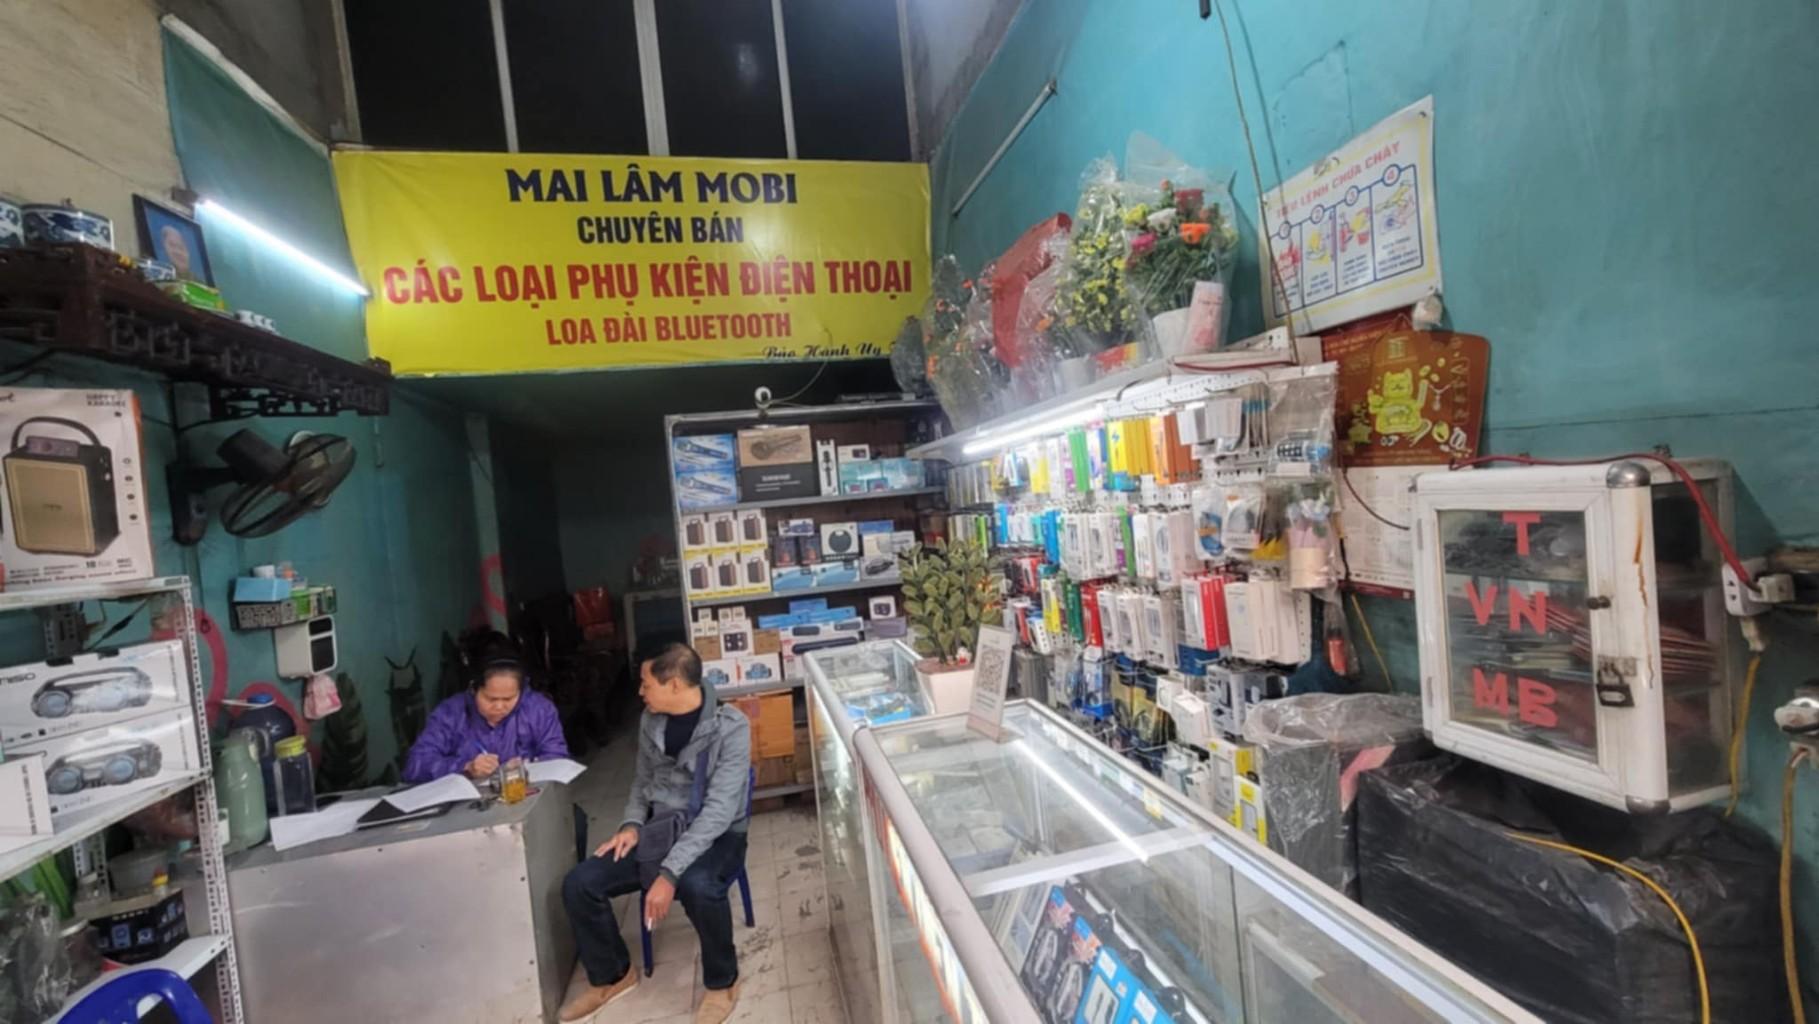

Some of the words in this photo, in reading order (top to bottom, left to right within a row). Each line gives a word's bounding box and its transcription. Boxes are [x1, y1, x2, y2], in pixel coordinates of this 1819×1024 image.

[505, 168, 588, 203] MAI
[600, 163, 684, 203] LÂM
[695, 171, 798, 204] MOBI
[577, 210, 683, 244] CHUYÊN
[691, 211, 744, 244] BÁN
[383, 258, 463, 304] CÁC
[473, 264, 557, 309] LOẠI
[567, 263, 639, 307] PHỤ
[649, 255, 730, 305] KIỆN
[739, 254, 816, 303] ĐIỆN
[824, 260, 912, 301] THOẠI
[546, 317, 597, 346] LOA
[603, 311, 647, 343] ĐÀI
[654, 312, 792, 341] BLUETOOTH
[1503, 511, 1542, 557] T
